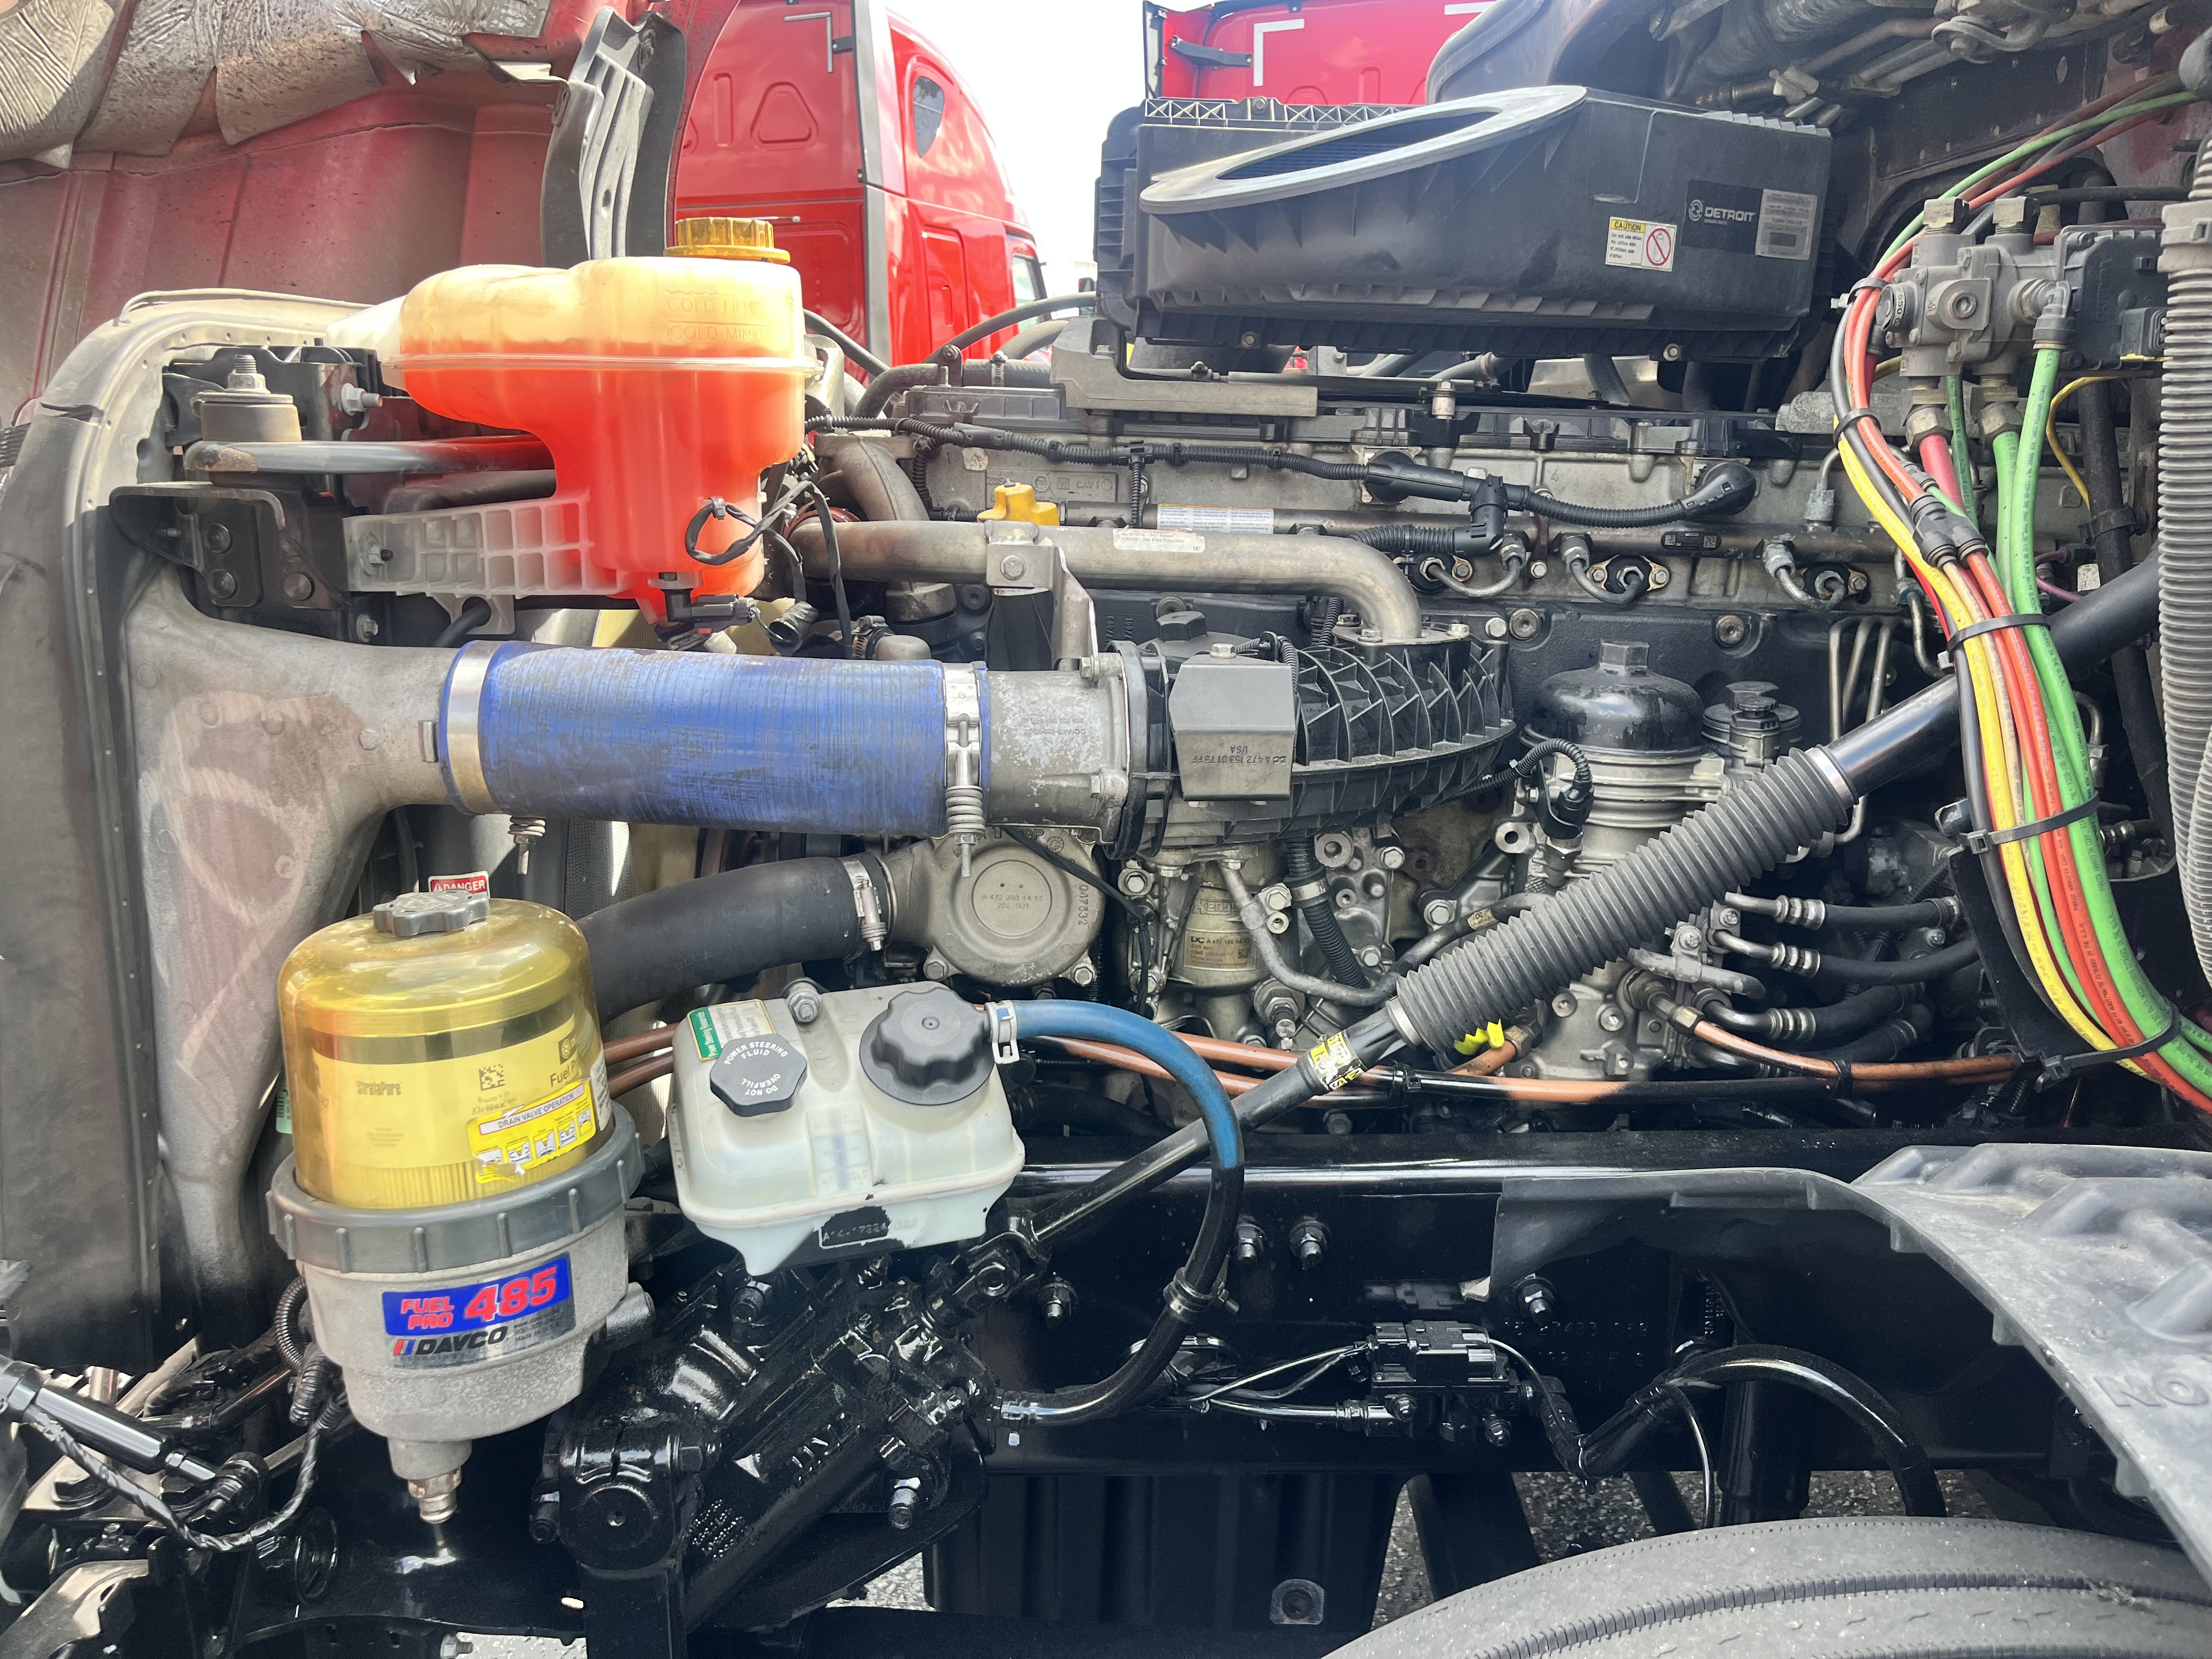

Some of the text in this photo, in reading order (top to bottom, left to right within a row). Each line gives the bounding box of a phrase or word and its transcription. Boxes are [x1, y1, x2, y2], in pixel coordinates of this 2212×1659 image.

[1705, 207, 1756, 222] DETROIT
[1615, 222, 1641, 231] CAUTION
[667, 297, 714, 313] COLD
[670, 325, 751, 341] COLD MIN
[1230, 746, 1248, 754] USA
[1229, 755, 1244, 764] 153
[1247, 755, 1262, 764] 472
[443, 879, 486, 891] DANGER
[724, 1041, 788, 1065] POWER STEERING
[741, 1049, 770, 1059] FLUID
[550, 1064, 570, 1087] Fuel
[741, 1073, 781, 1090] OVERFILL
[765, 1085, 778, 1093] DO
[499, 1115, 521, 1128] DRAIN
[522, 1107, 544, 1123] VALVE
[544, 1093, 574, 1112] OPERATION
[465, 1267, 557, 1322] 485
[401, 1295, 455, 1314] FUEL
[408, 1312, 454, 1330] PRO
[415, 1325, 509, 1356] DAVCO
[515, 1333, 532, 1342] Made
